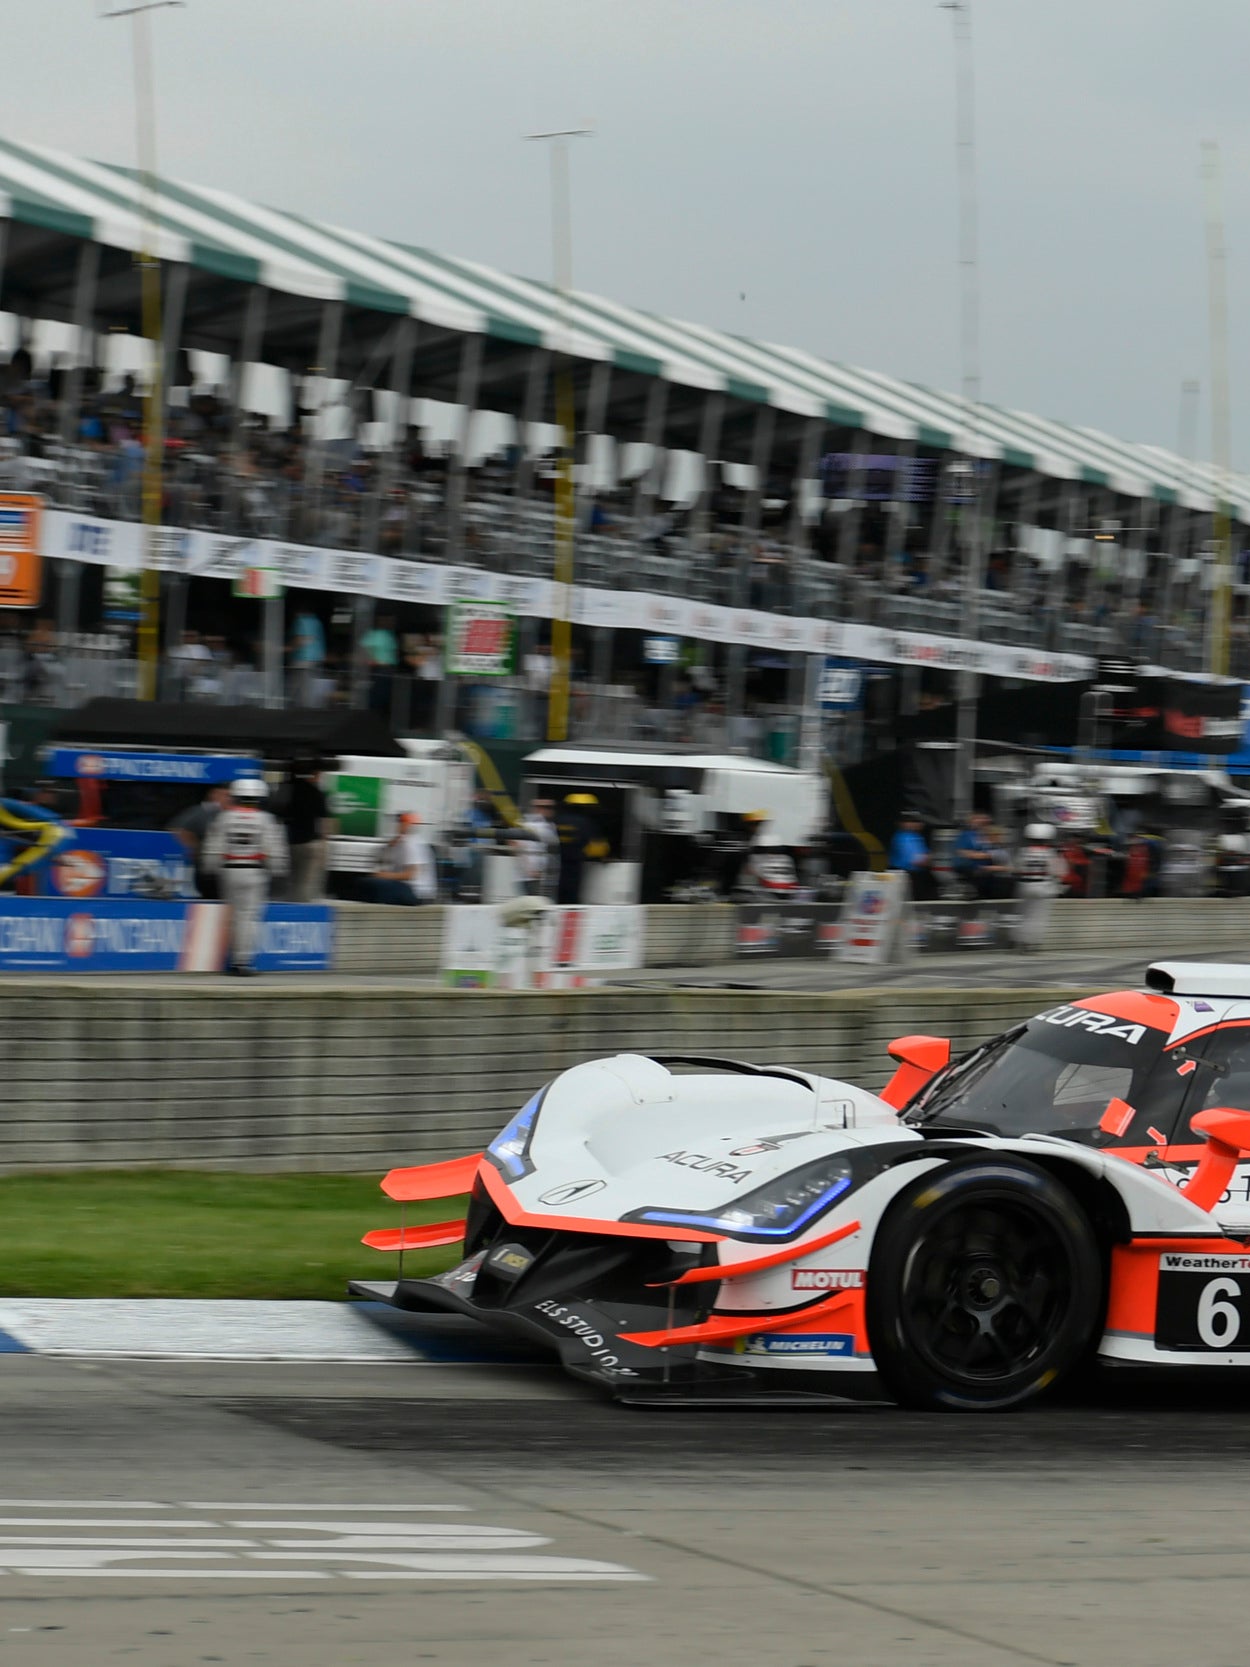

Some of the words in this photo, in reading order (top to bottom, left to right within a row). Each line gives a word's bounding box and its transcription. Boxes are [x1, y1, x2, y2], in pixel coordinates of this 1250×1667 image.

[1035, 1004, 1148, 1045] URA
[655, 1150, 753, 1184] ACURA
[794, 1271, 864, 1288] MOTUL
[1197, 1277, 1241, 1348] 6
[534, 1300, 568, 1317] ELS
[559, 1315, 619, 1367] STUDIO
[767, 1341, 846, 1350] MICHELIN
